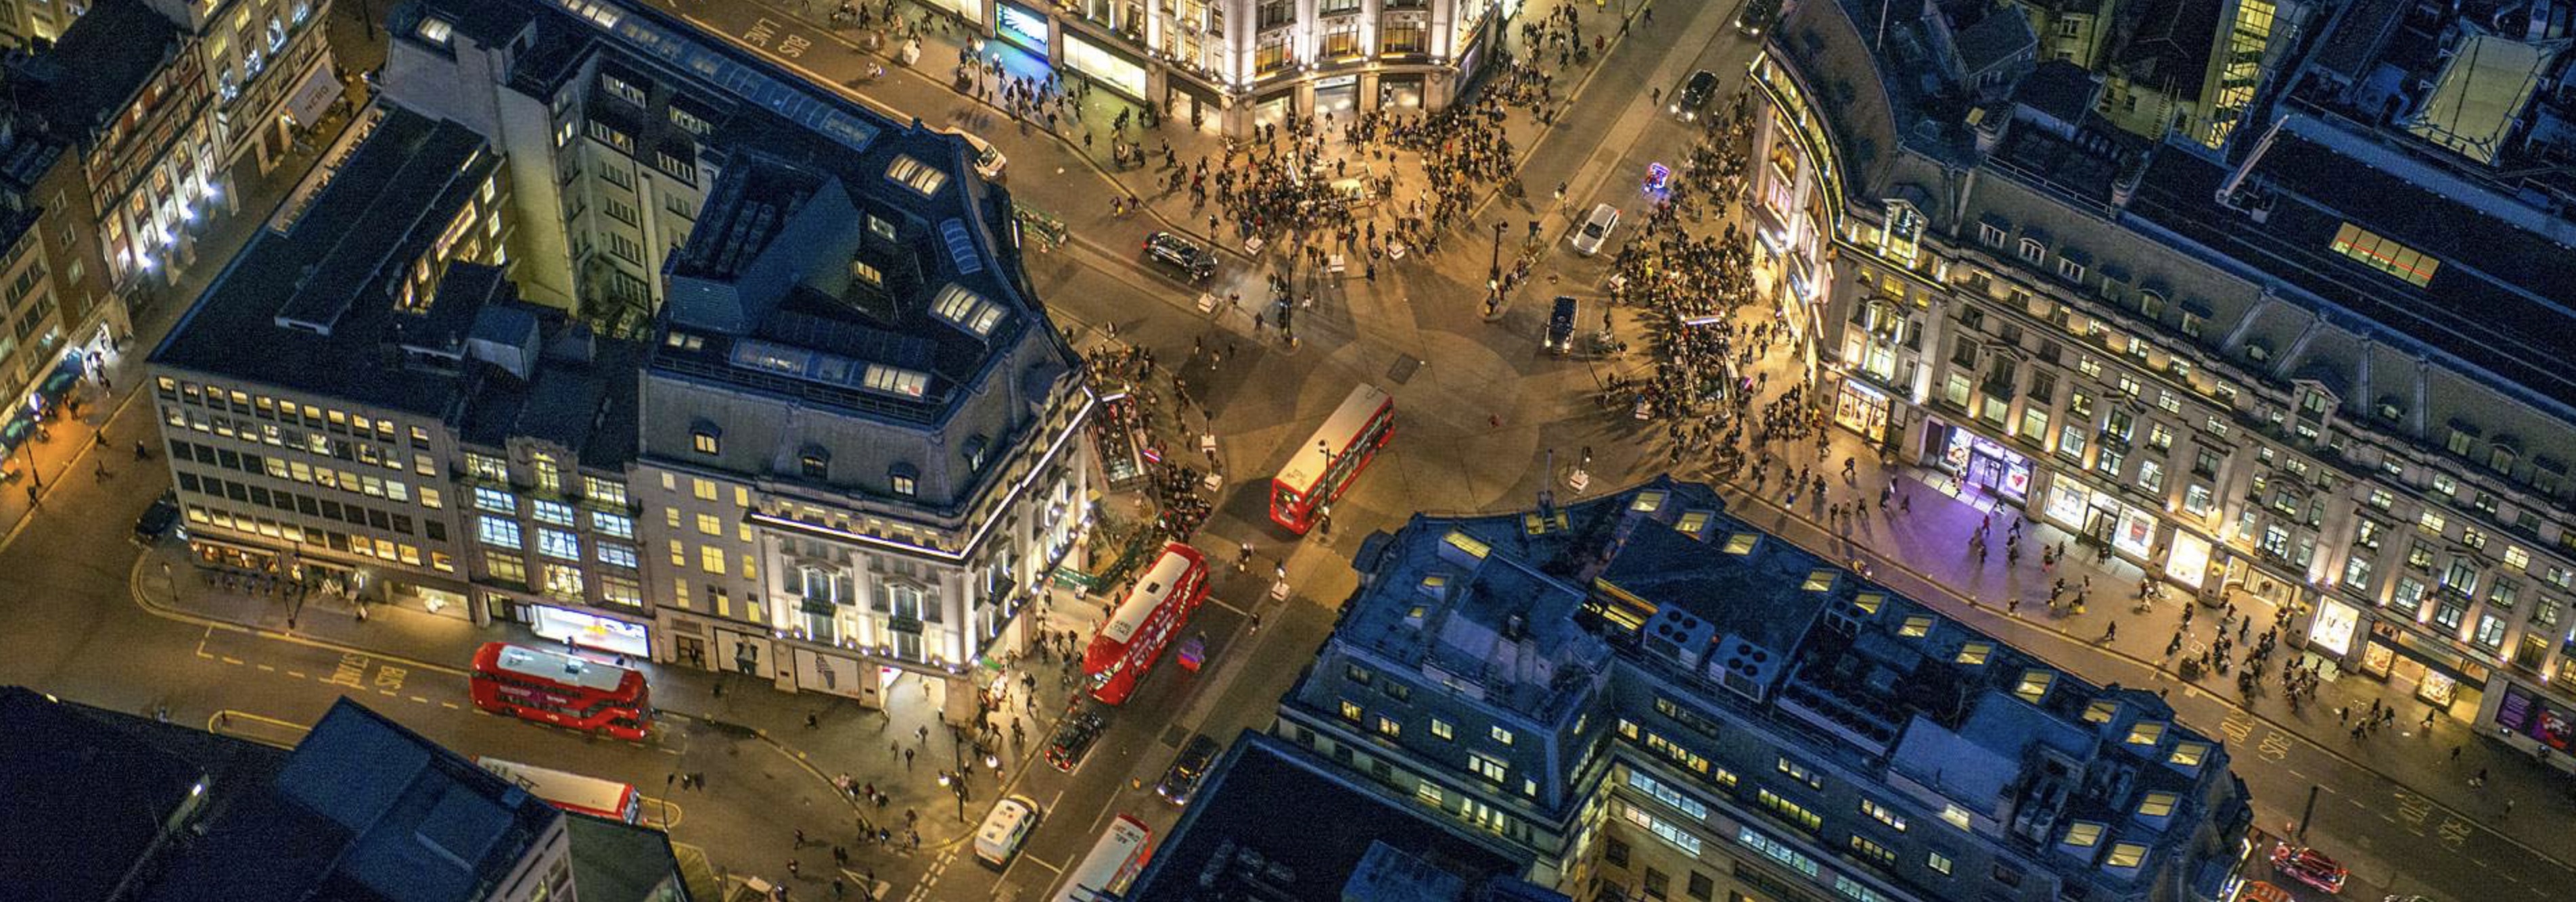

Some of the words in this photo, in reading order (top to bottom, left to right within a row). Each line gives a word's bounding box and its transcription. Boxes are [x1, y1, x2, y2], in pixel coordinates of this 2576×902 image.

[743, 18, 781, 47] LANE
[779, 34, 811, 57] BUS
[304, 85, 329, 114] NERO
[375, 665, 407, 689] BUS
[2259, 732, 2293, 759] BUS
